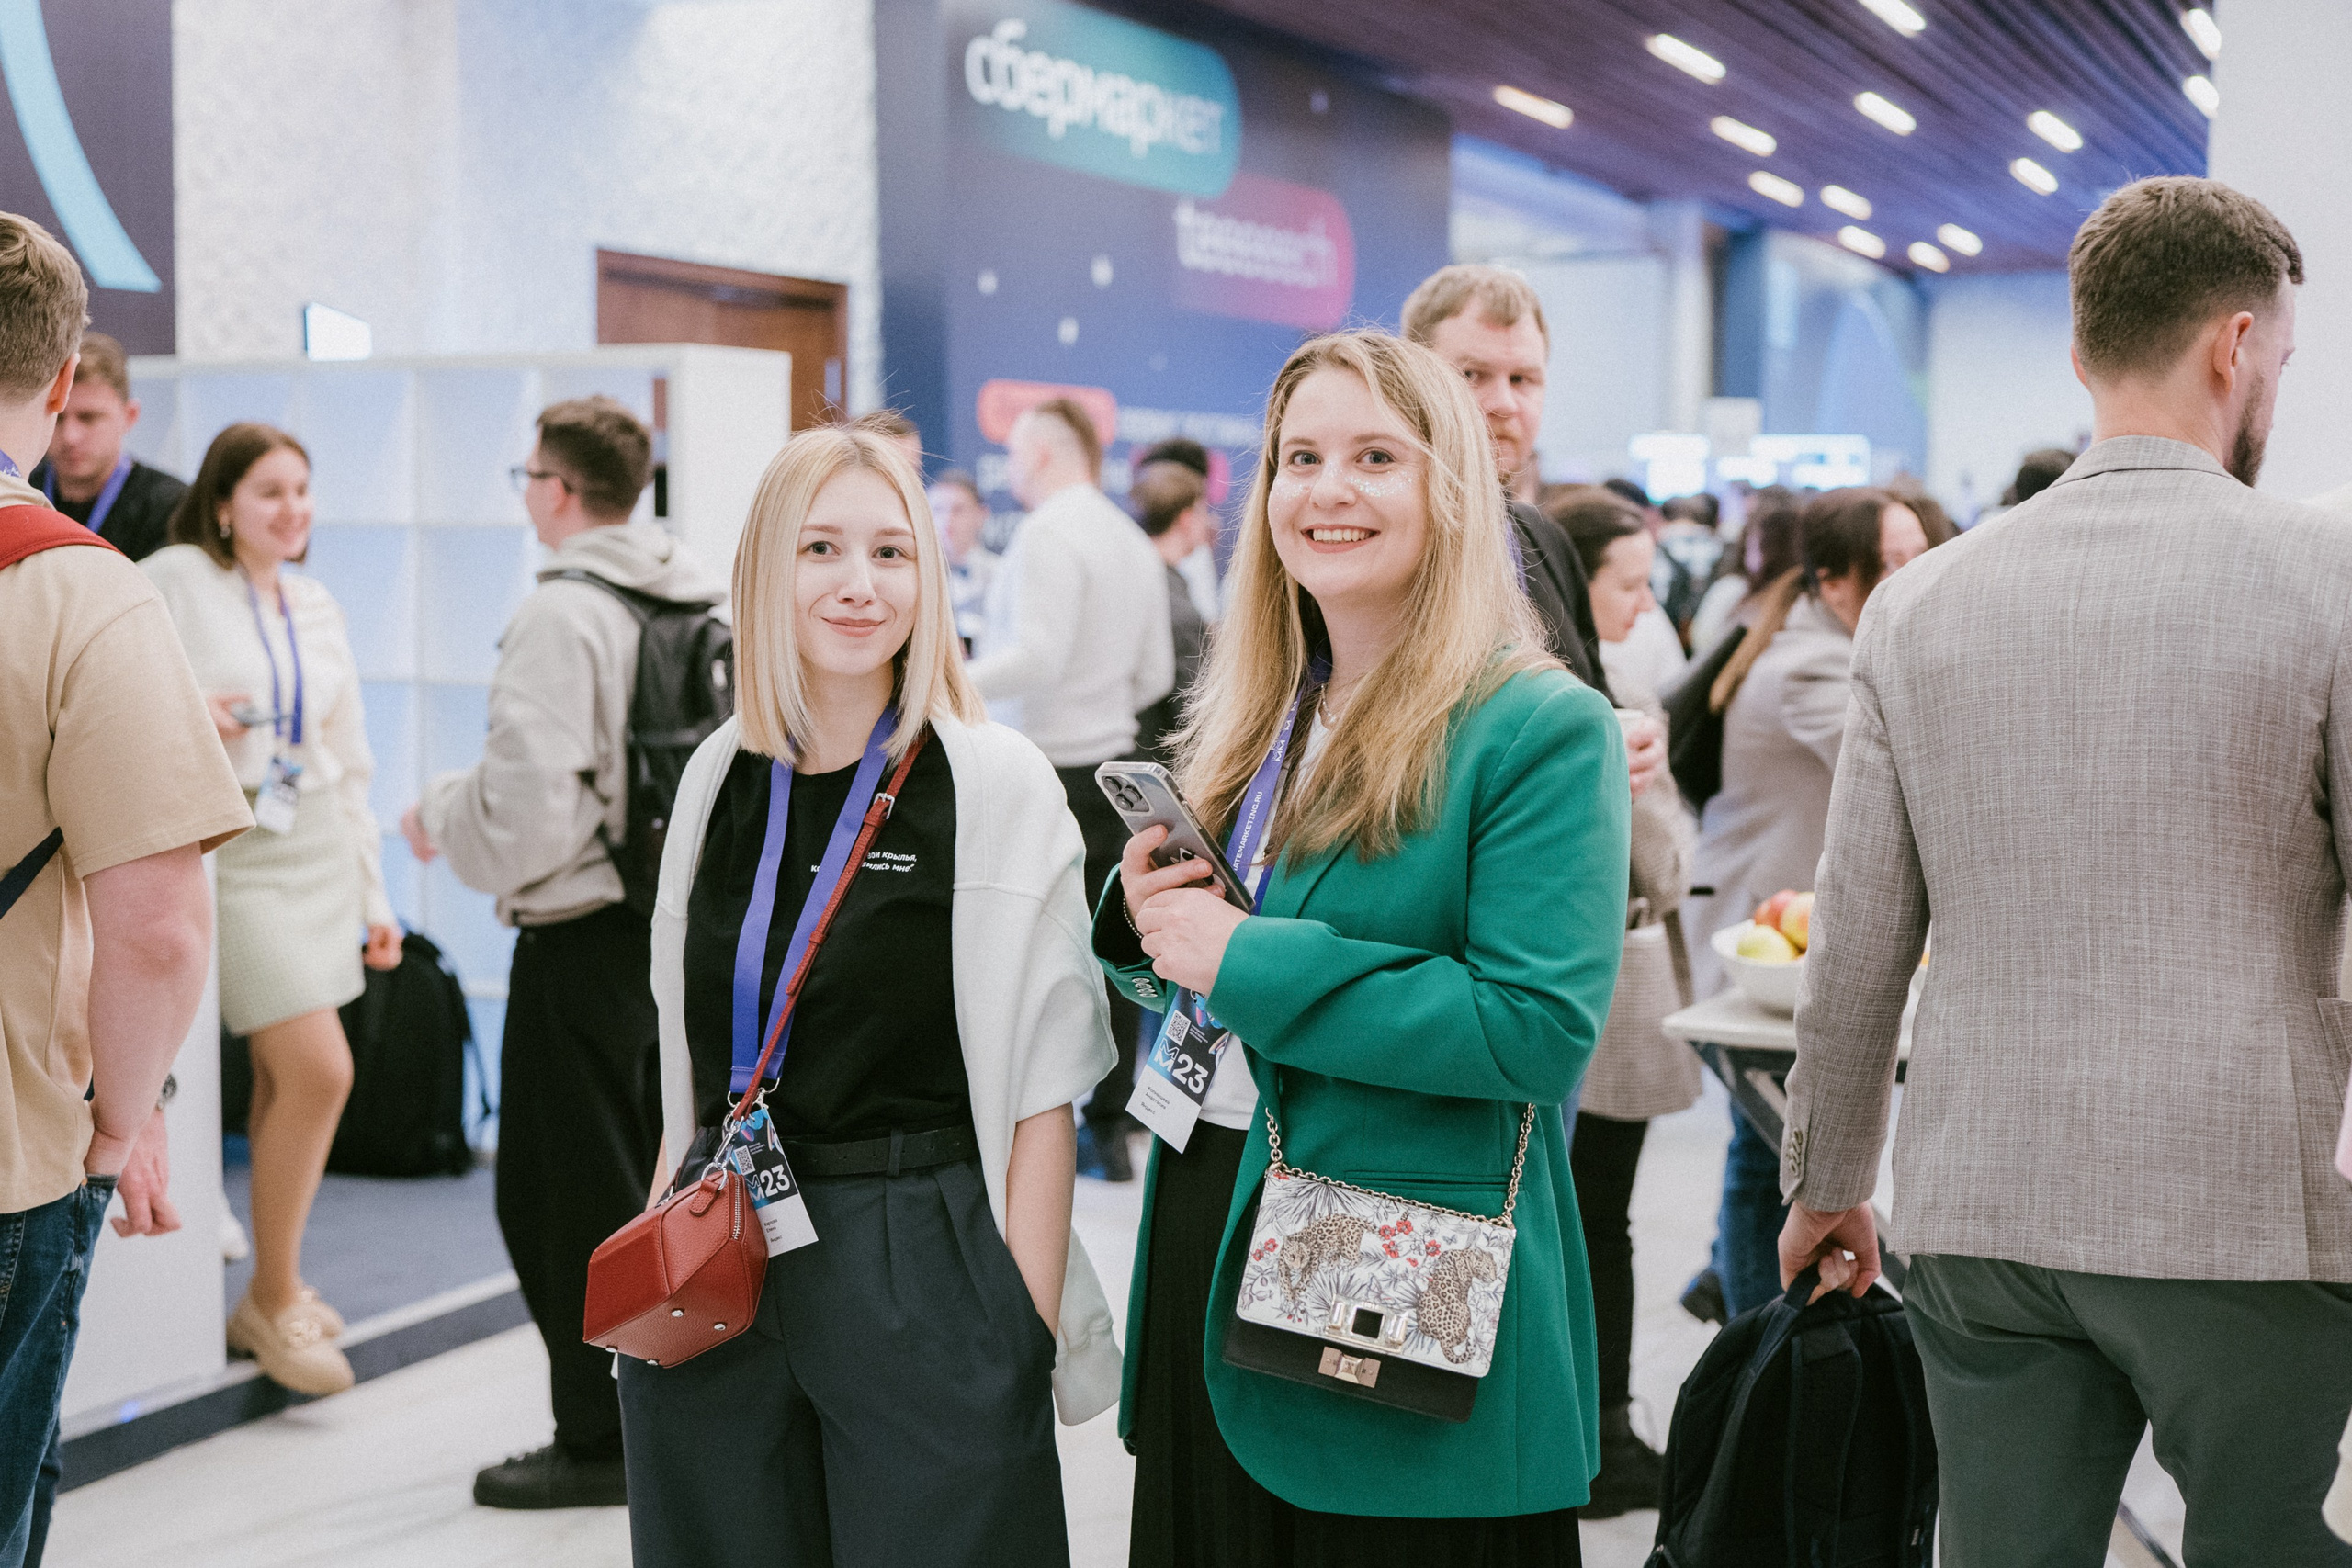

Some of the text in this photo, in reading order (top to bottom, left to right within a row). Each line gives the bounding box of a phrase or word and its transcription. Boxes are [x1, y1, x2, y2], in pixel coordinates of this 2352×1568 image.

[1232, 791, 1263, 872] ATEMARKETING.RU
[882, 852, 917, 863] крылья,
[1171, 1053, 1209, 1094] 23
[759, 1164, 791, 1198] 23
